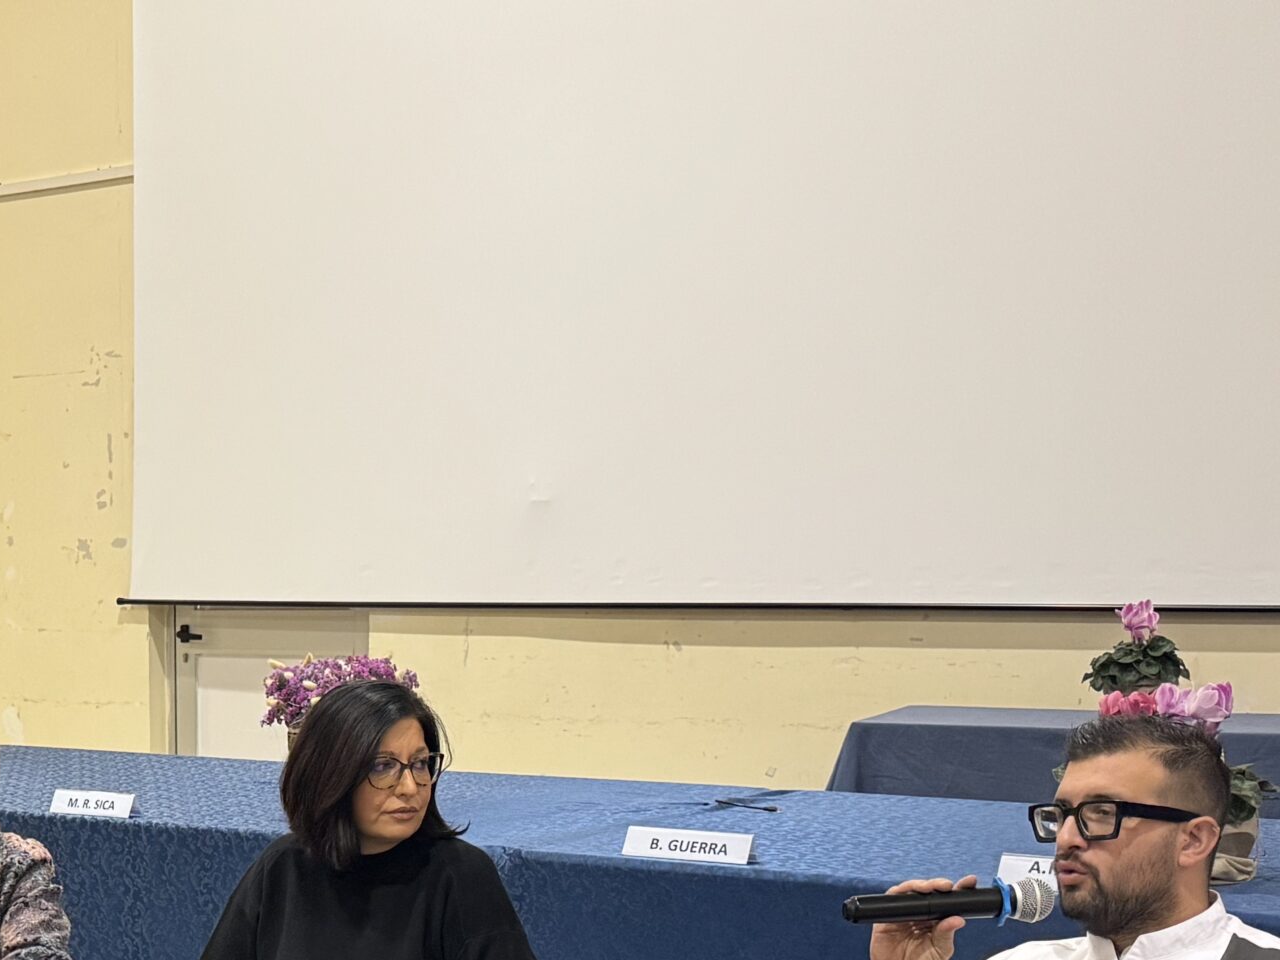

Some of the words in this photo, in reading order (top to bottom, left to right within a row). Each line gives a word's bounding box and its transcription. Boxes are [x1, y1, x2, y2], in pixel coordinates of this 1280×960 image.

[67, 798, 80, 809] M.
[82, 799, 91, 809] R.
[93, 800, 115, 811] SICA
[649, 838, 663, 851] B.
[667, 840, 728, 856] GUERRA
[1028, 861, 1046, 874] A.
